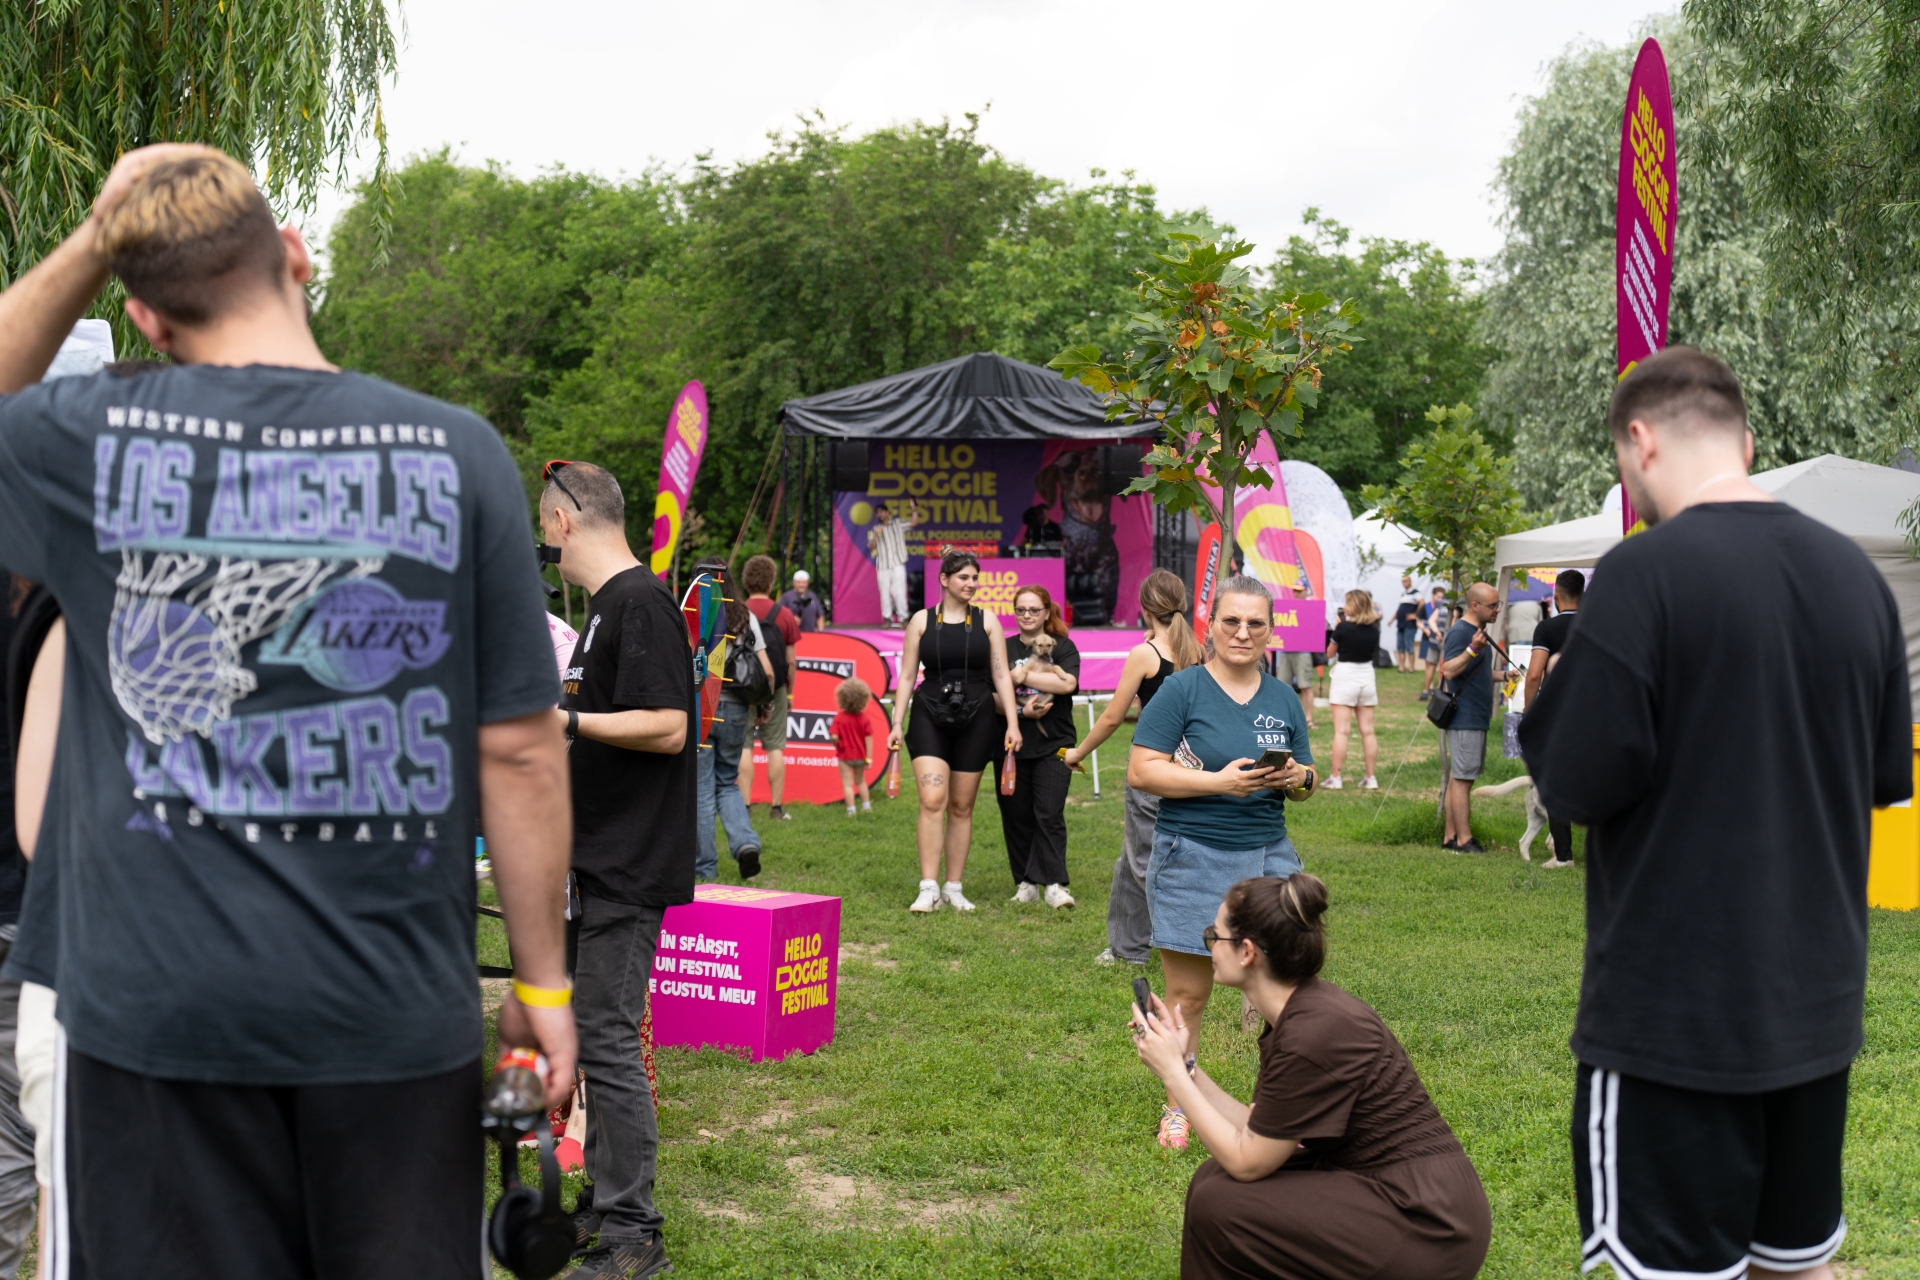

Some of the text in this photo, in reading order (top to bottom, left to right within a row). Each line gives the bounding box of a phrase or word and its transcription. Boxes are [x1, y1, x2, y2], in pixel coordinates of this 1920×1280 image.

[1637, 86, 1666, 163] HELLO
[1629, 111, 1670, 216] DOGGIE
[1632, 156, 1667, 256] FESTIVAL
[106, 406, 448, 448] WESTERN CONFERENCE
[884, 444, 975, 469] HELLO
[866, 471, 998, 496] DOGGIE
[94, 434, 461, 574] LOS ANGELES
[976, 569, 1018, 586] ELLO
[1201, 545, 1219, 602] PURINA
[125, 686, 454, 816] LAKERS
[1257, 734, 1286, 744] ASPA
[660, 929, 739, 959] ÎN SFÂRȘIT,
[784, 932, 822, 963] HELLO
[655, 956, 742, 981] UN FESTIVAL
[775, 957, 829, 992] DOGGIE
[660, 980, 716, 1001] GUSTUL
[719, 986, 757, 1006] MEU!
[781, 982, 829, 1016] FESTIVAL
